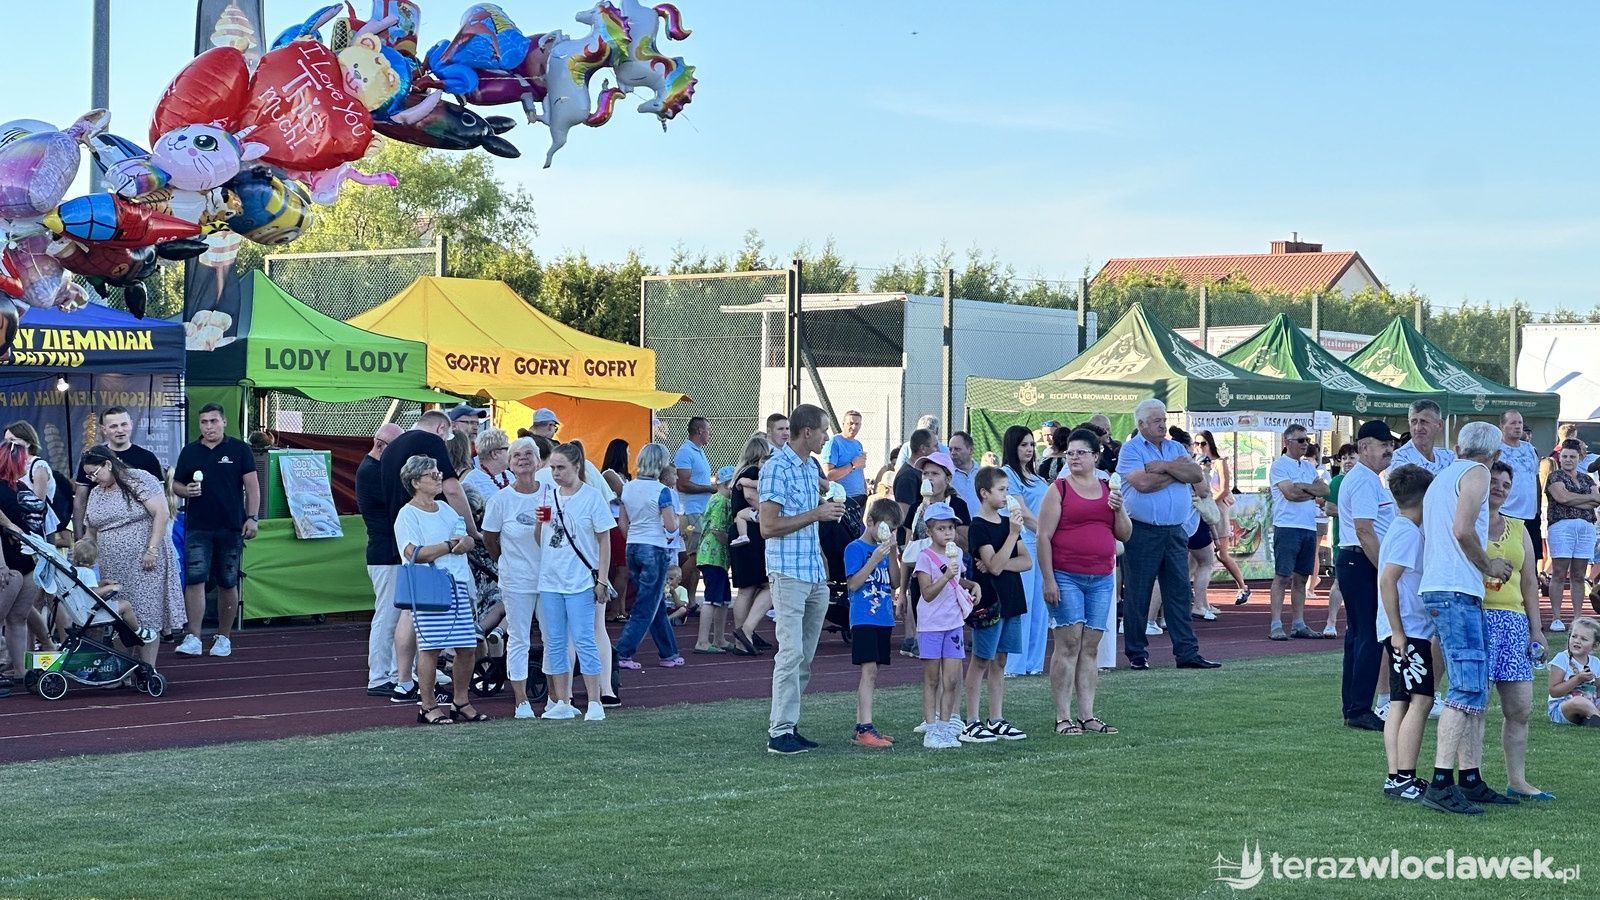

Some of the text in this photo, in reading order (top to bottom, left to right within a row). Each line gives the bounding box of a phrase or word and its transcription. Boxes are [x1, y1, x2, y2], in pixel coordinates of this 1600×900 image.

[298, 43, 366, 138] I Love You
[40, 329, 153, 350] ZIEMNIAK
[12, 351, 85, 368] PATYKU
[265, 347, 408, 373] LODY LODY
[445, 352, 638, 377] GOFRY GOFRY GOFRY
